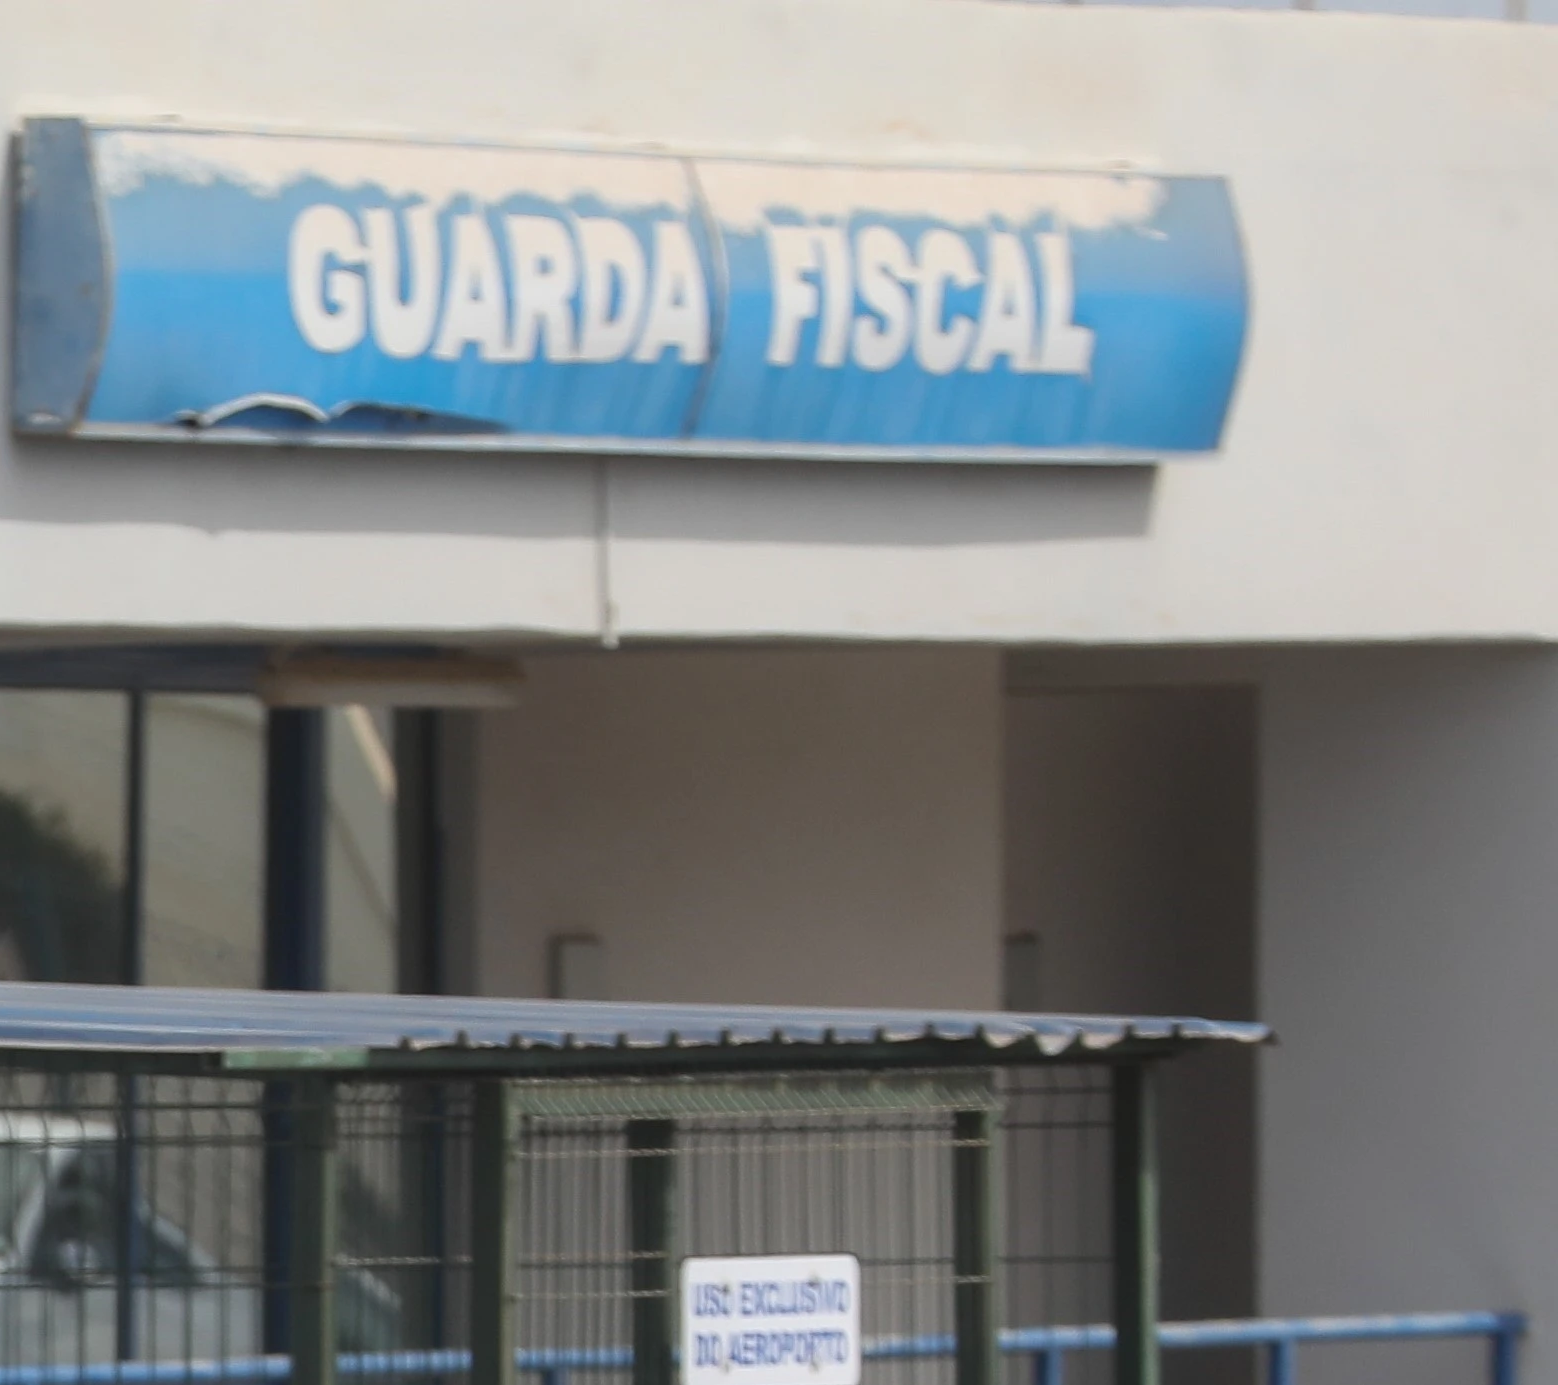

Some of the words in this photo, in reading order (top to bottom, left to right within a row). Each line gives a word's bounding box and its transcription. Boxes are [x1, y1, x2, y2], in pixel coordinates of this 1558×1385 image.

[287, 203, 710, 366] GUARDA
[767, 222, 1093, 378] FISCAL
[693, 1282, 731, 1317] USO
[740, 1279, 848, 1316] EXCLUSIVO
[729, 1328, 846, 1366] AEROPORTO
